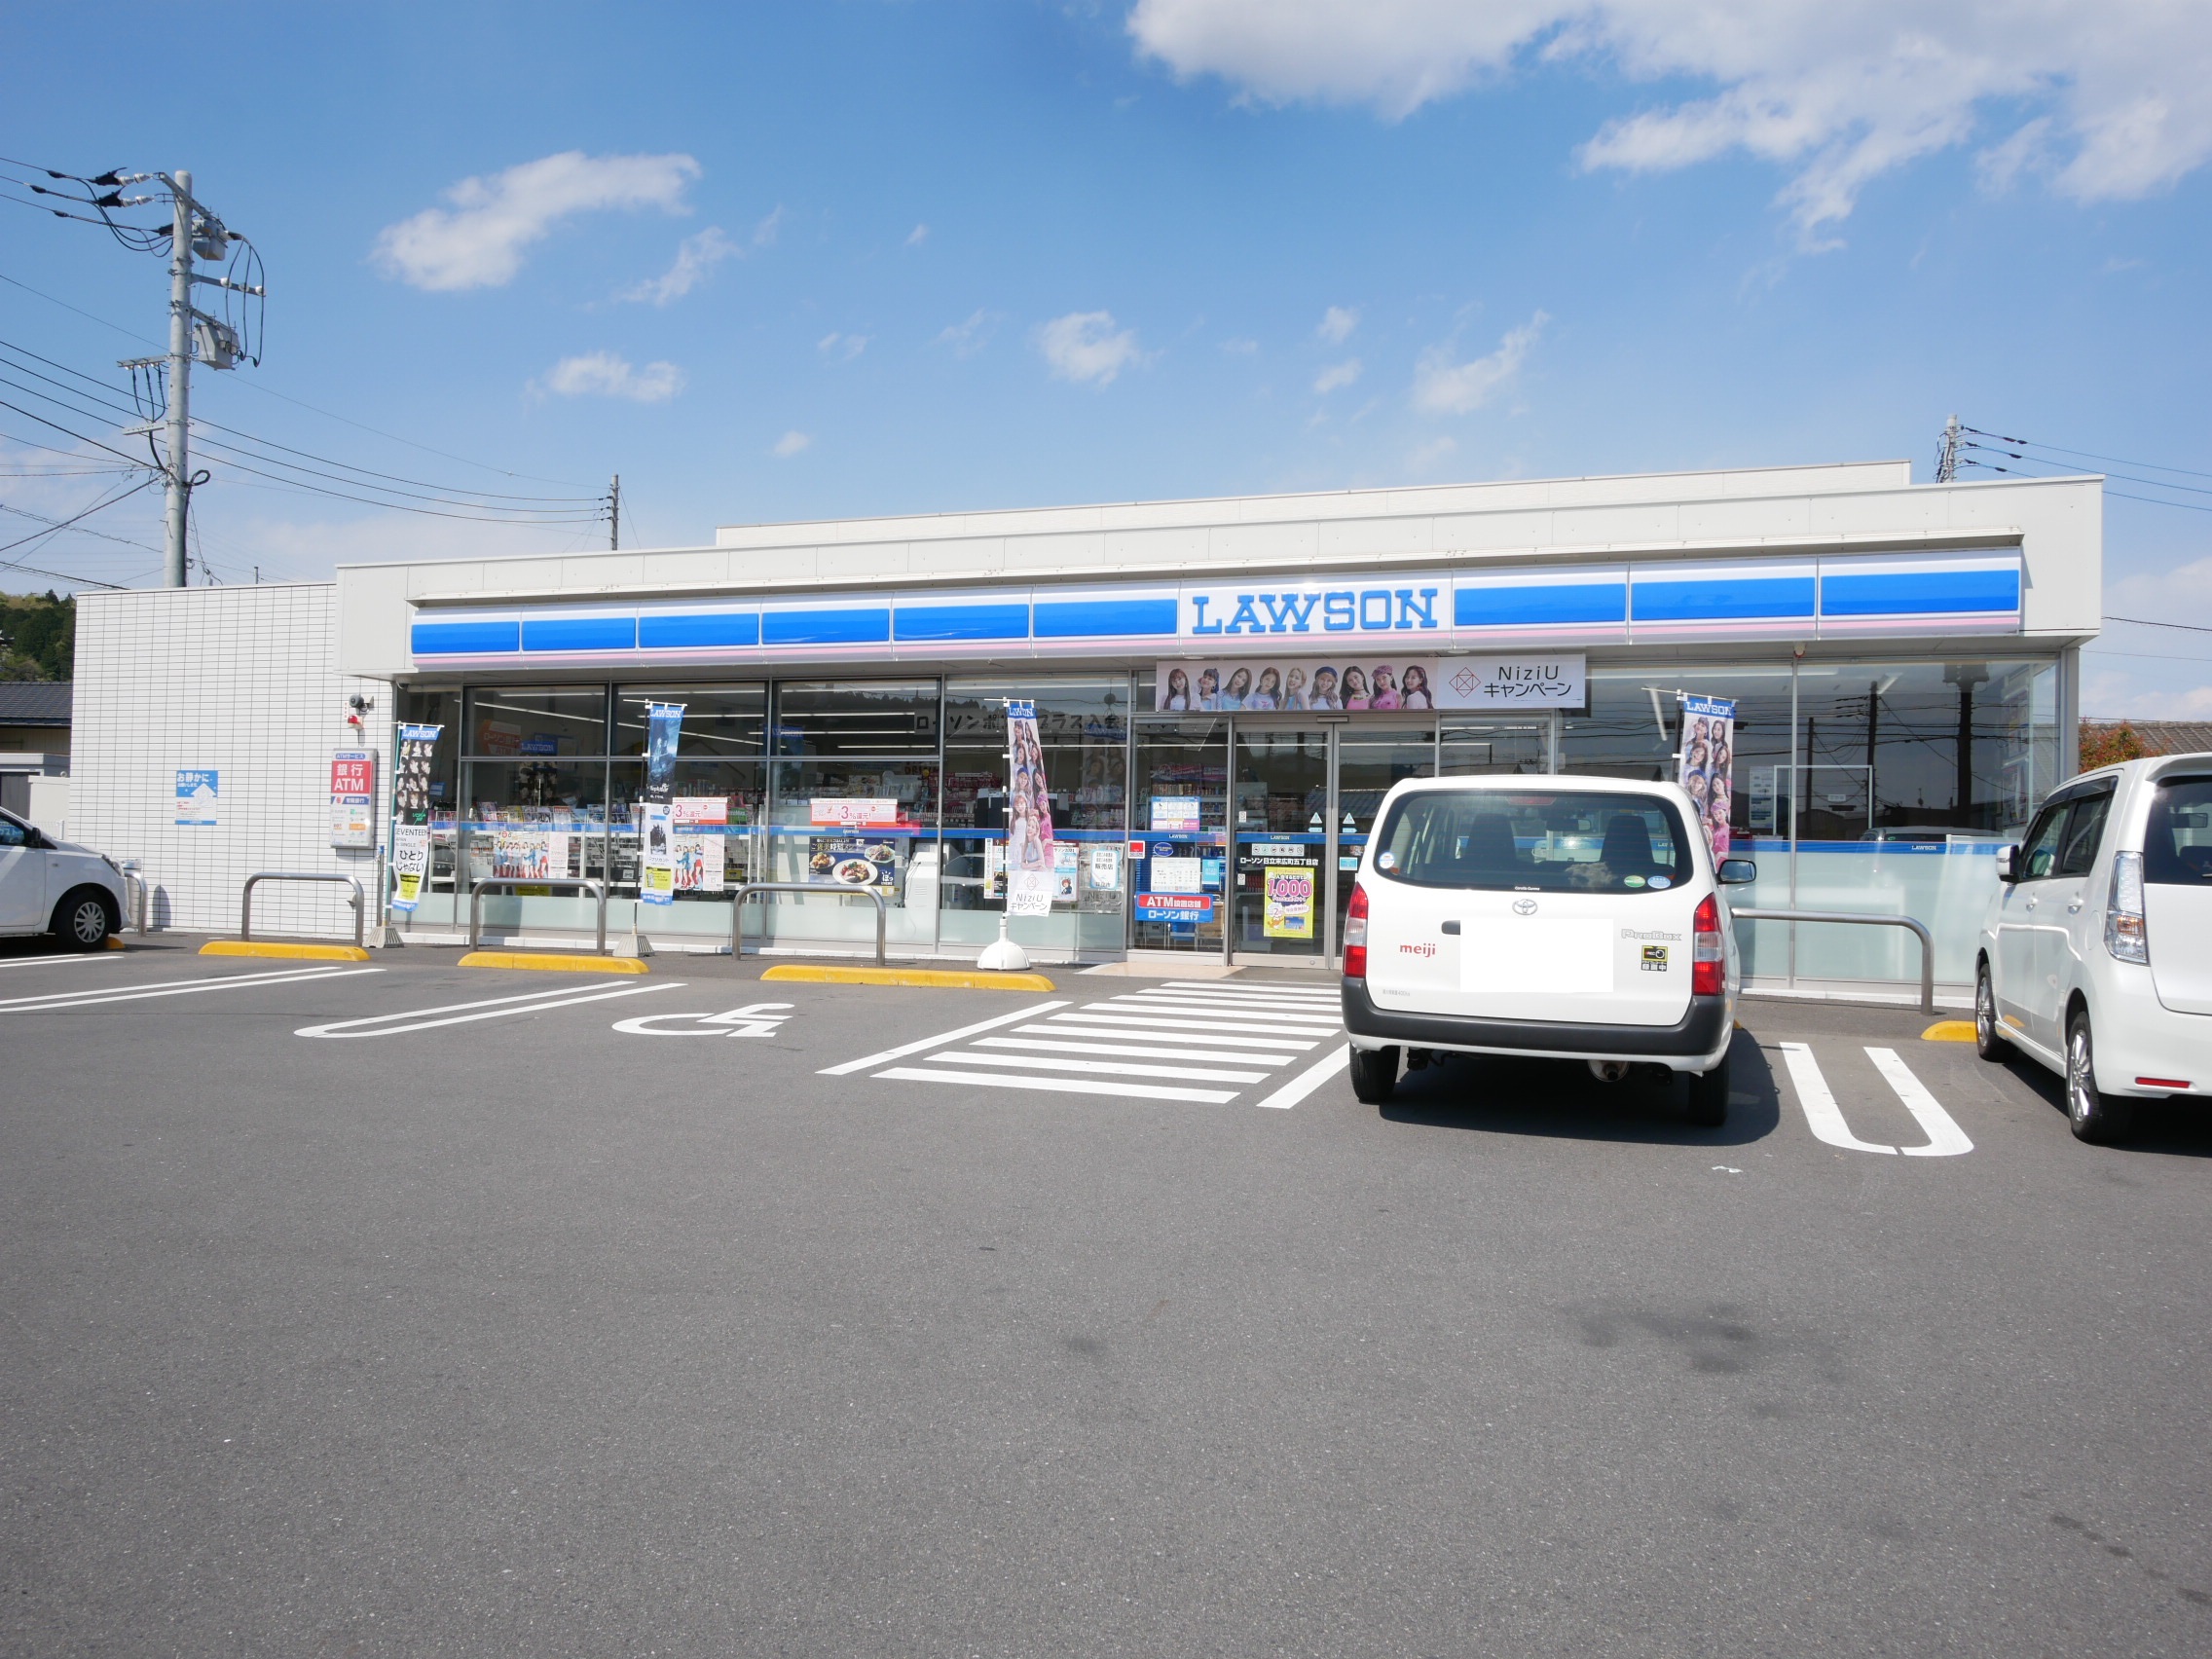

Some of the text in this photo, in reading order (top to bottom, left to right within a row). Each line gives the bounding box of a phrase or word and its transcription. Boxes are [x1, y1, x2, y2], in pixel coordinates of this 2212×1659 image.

[1193, 588, 1438, 634] LAWSON
[1498, 666, 1559, 681] NiziU
[1484, 682, 1571, 698] キャンペーン
[1686, 702, 1732, 716] LAWSON
[402, 729, 436, 738] LAWSON
[337, 763, 363, 776] 銀行
[334, 778, 364, 792] ATM
[399, 850, 424, 861] ひとり
[396, 861, 424, 872] じゃない
[1011, 902, 1048, 911] キャンペーン
[1148, 909, 1199, 921] ローソン銀行
[1399, 942, 1436, 958] meiji
